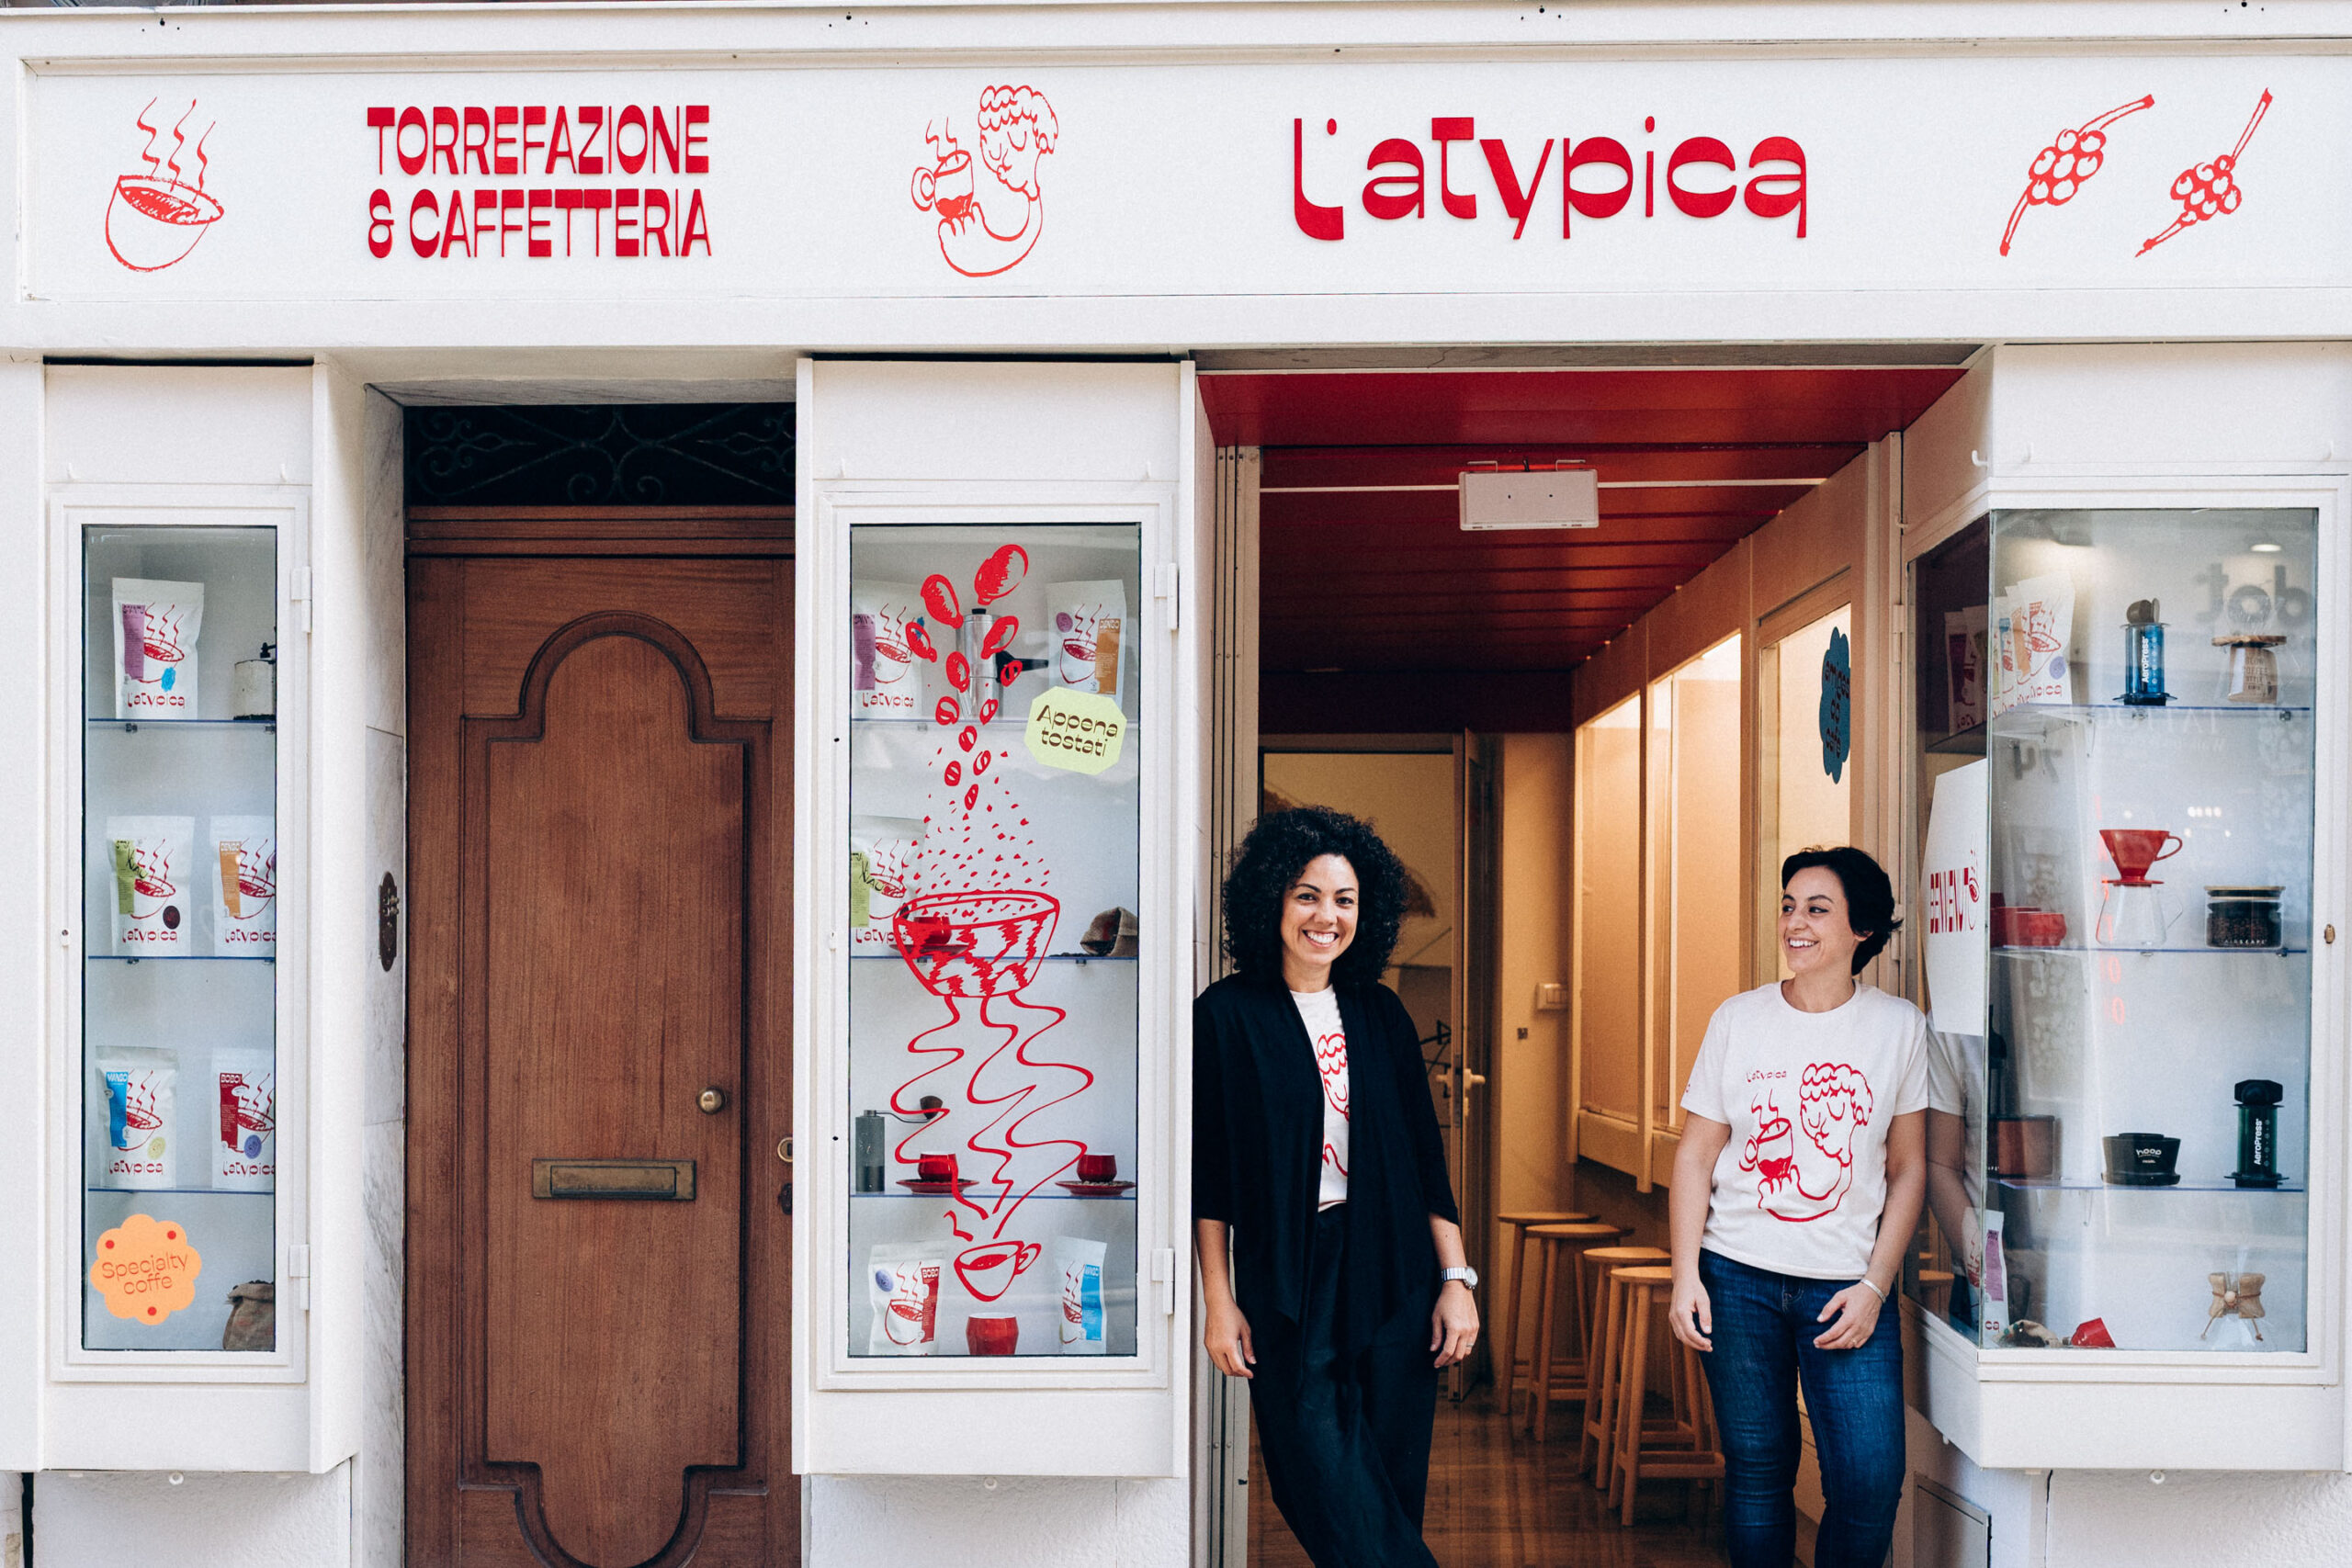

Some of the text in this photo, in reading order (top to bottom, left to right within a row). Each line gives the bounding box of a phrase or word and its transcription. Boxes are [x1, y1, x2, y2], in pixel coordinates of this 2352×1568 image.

[367, 105, 710, 175] TORREFAZIONE
[368, 188, 712, 259] & CAFFETTERIA
[1035, 705, 1118, 739] Appena
[1041, 730, 1108, 757] tostati
[2254, 1118, 2262, 1165] AeroPress
[102, 1252, 188, 1280] Specialty
[124, 1272, 173, 1295] coffe
